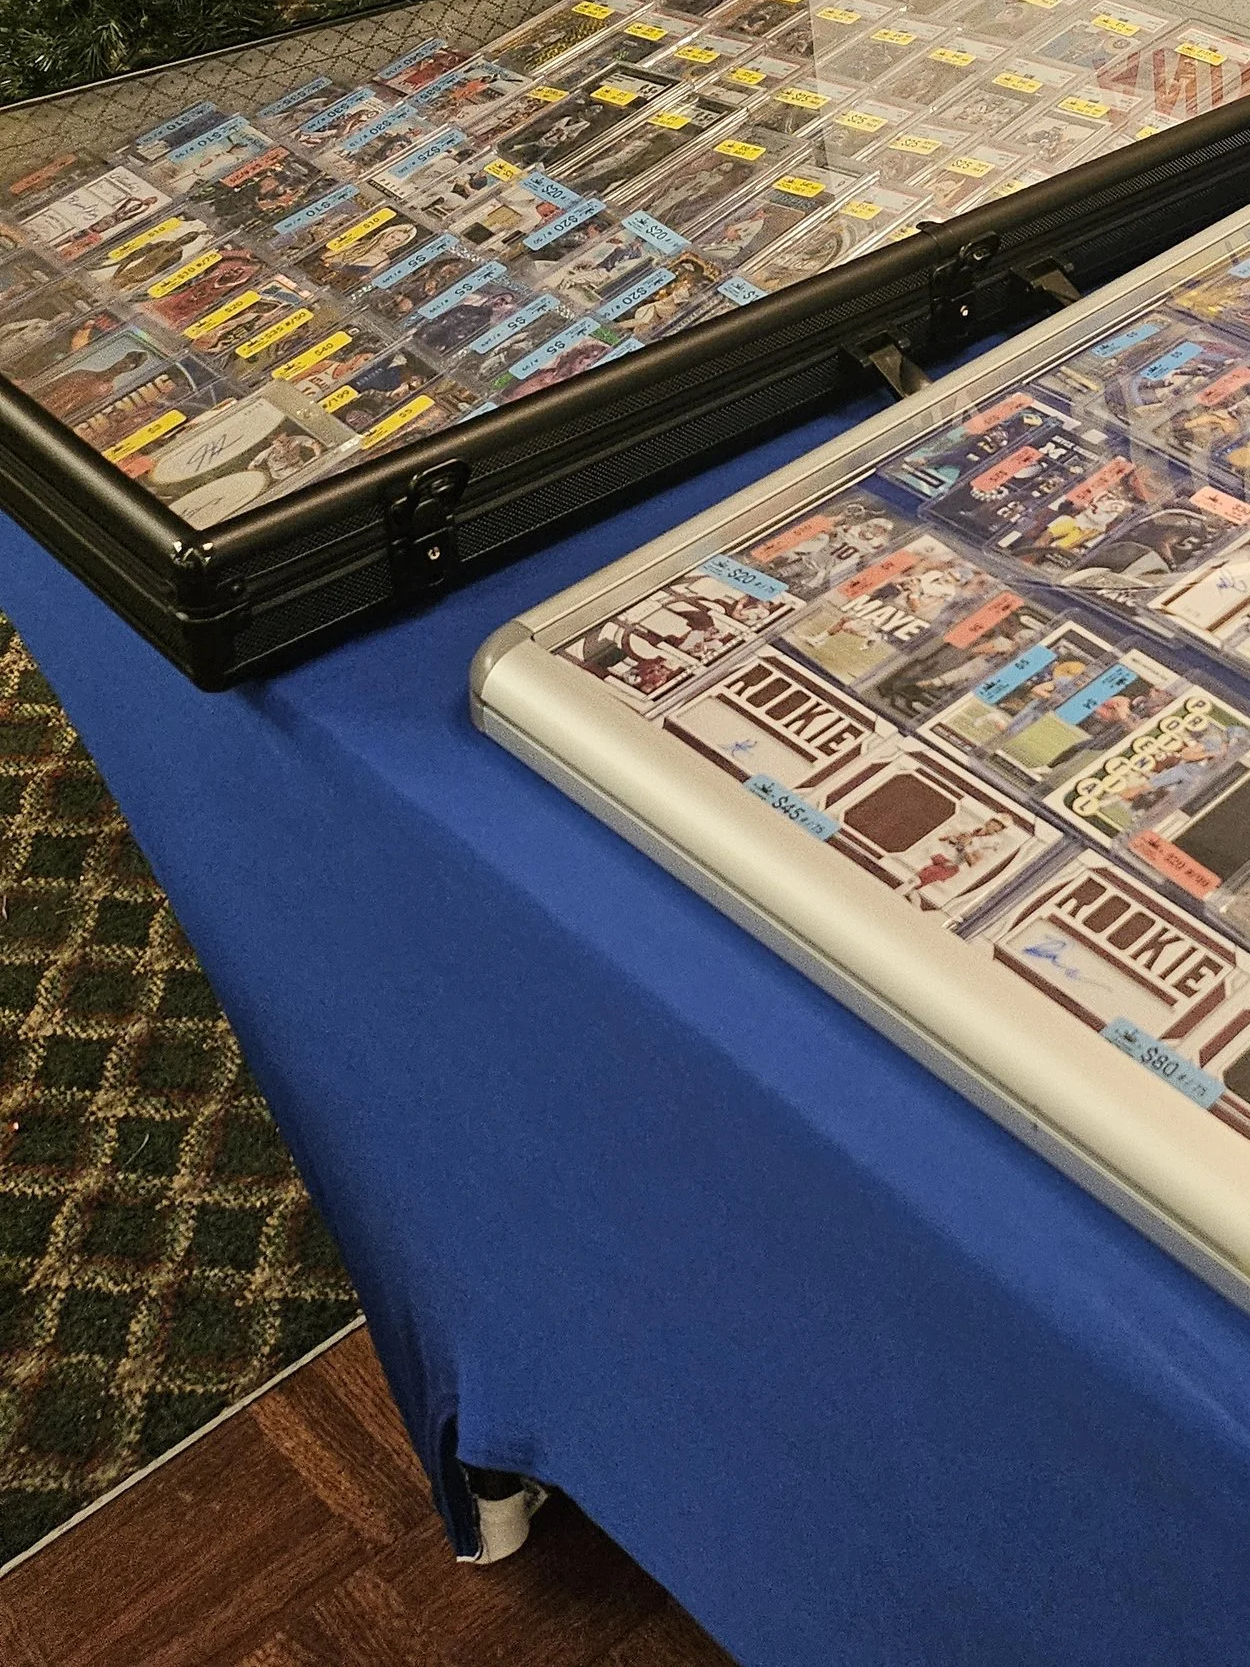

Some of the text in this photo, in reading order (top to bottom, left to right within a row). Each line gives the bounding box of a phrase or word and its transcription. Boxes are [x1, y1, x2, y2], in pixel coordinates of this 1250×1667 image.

[197, 131, 222, 147] $10
[417, 145, 441, 162] $25
[541, 184, 563, 199] $20
[305, 201, 331, 217] $10
[553, 214, 578, 232] $20
[645, 224, 668, 240] $20
[407, 254, 427, 268] $5
[454, 282, 473, 297] $5
[621, 286, 647, 305] $20
[507, 315, 526, 330] $5
[546, 340, 566, 355] $5
[727, 568, 756, 584] $20
[840, 595, 931, 641] MAYE
[724, 663, 866, 756] ROOKIE
[771, 795, 805, 820] $45
[1056, 876, 1223, 999] ROOKIE
[1140, 1047, 1179, 1077] $80
